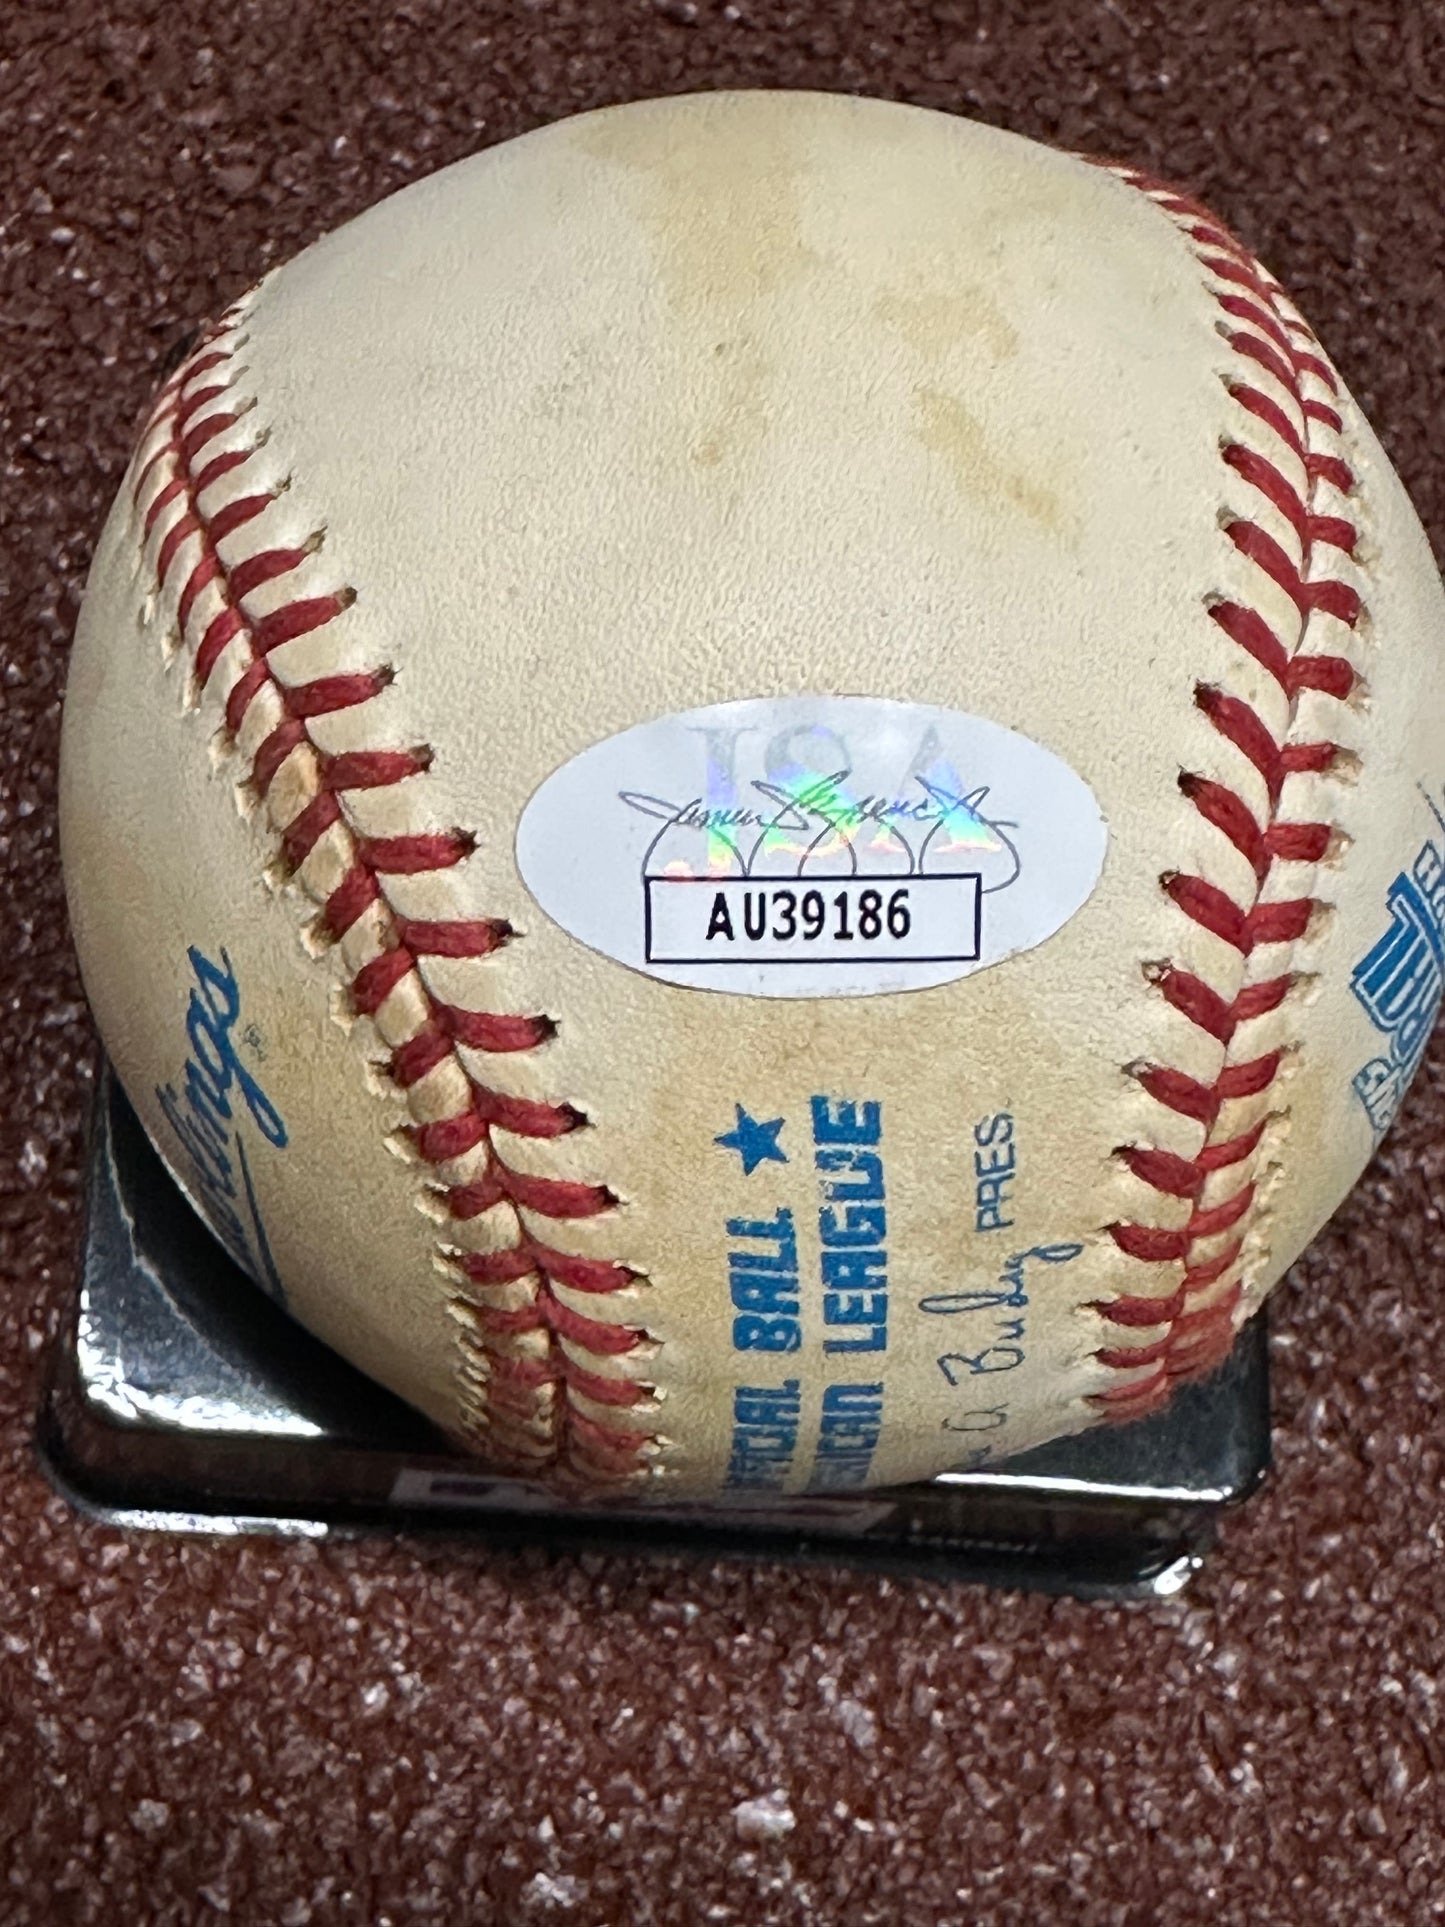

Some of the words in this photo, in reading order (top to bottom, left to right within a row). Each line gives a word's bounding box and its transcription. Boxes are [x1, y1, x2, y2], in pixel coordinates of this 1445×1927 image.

[688, 722, 1002, 878] JSA
[705, 887, 912, 942] AU39186
[810, 1094, 889, 1358] LEAGUE
[973, 1112, 1016, 1232] PRES
[726, 1206, 800, 1352] BALL
